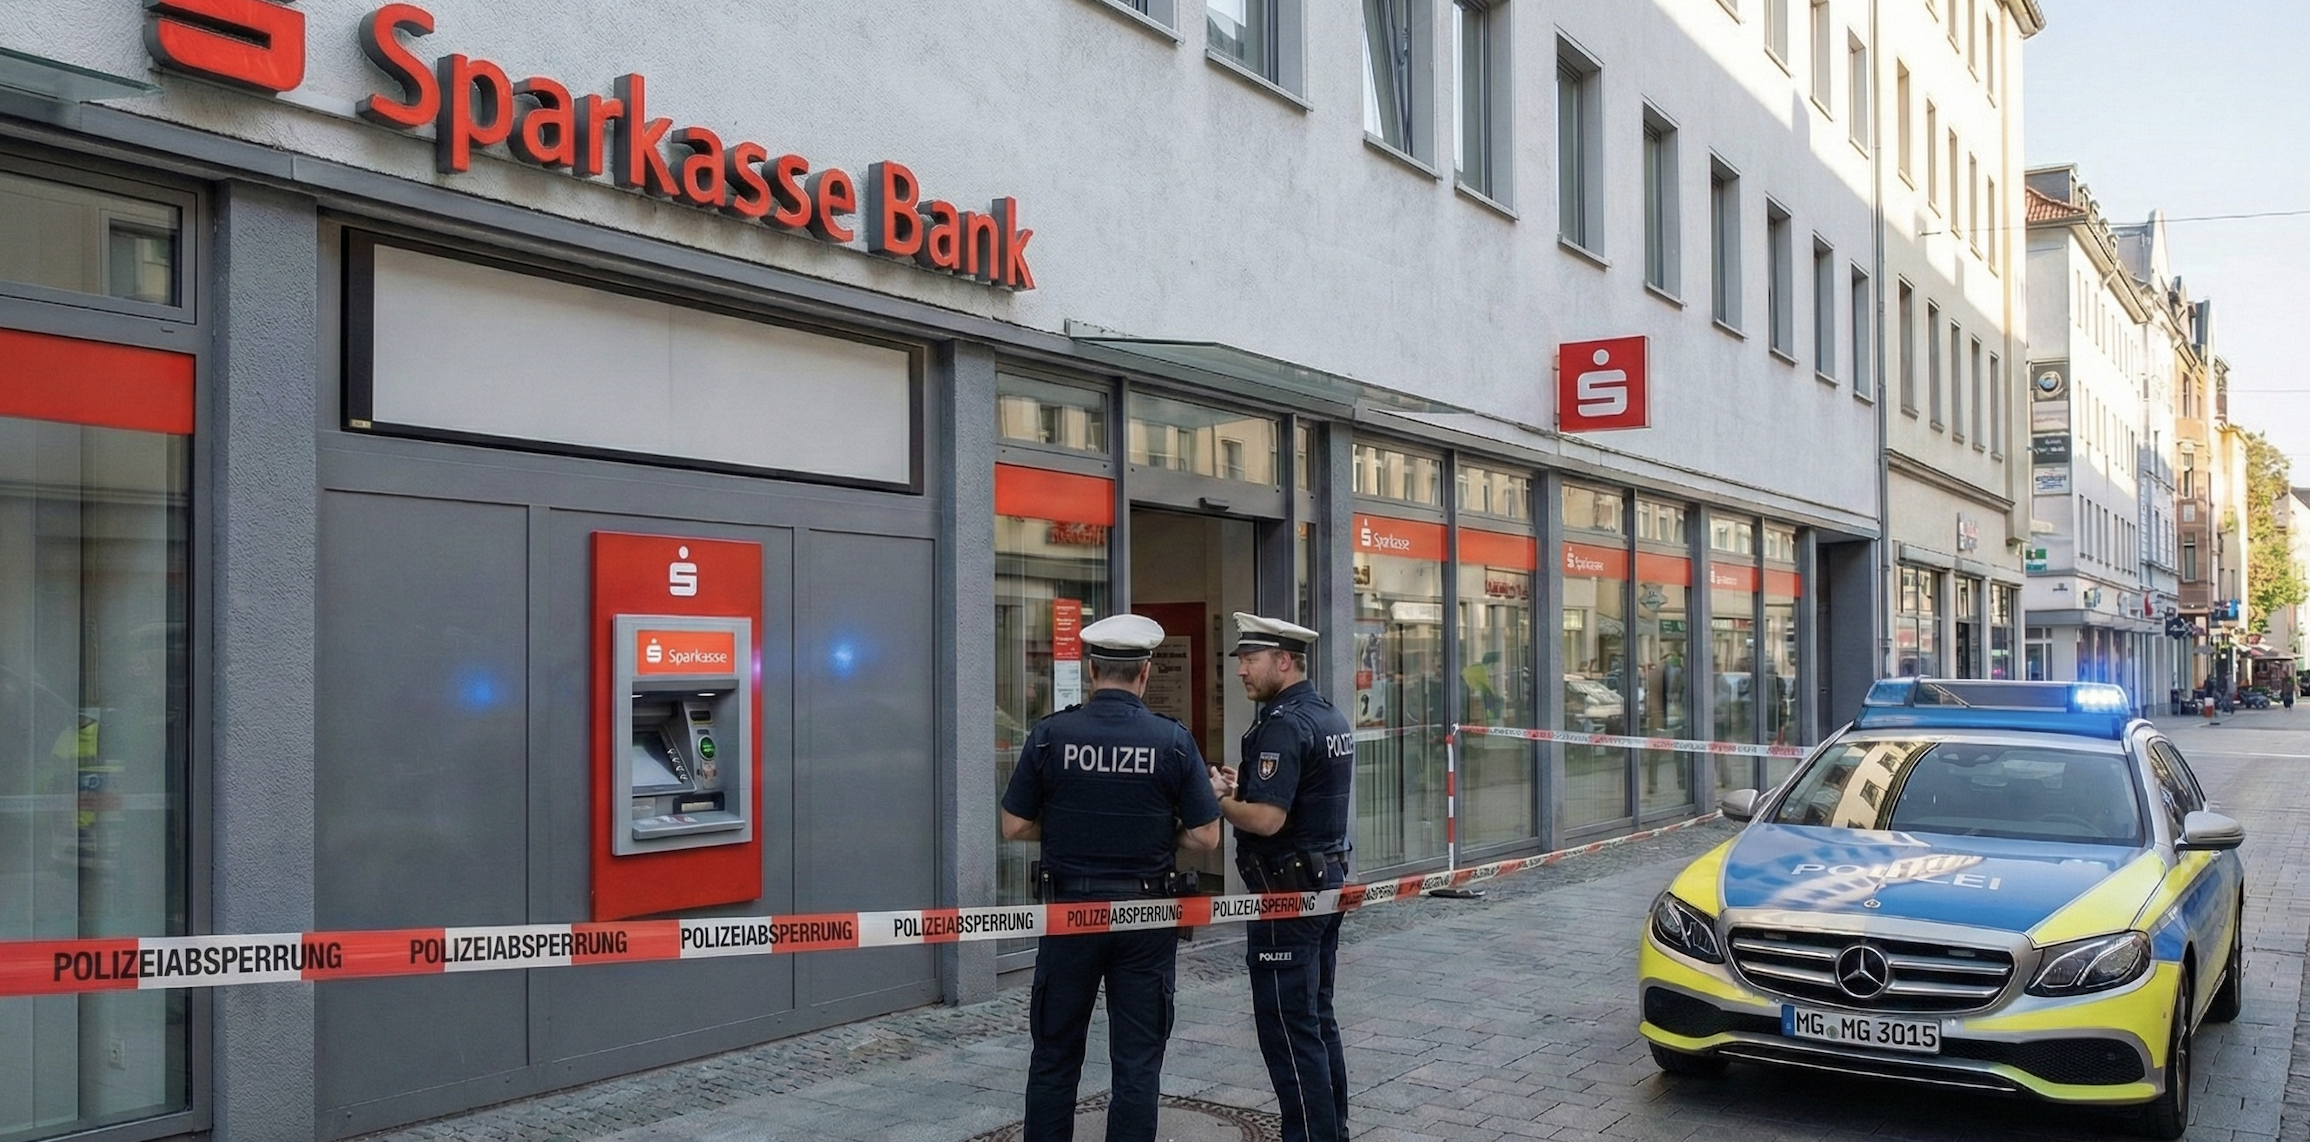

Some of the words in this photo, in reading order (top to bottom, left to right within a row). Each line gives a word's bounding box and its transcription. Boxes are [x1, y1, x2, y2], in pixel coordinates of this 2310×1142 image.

[356, 3, 856, 243] Sparkasse
[869, 160, 1036, 290] Bank
[668, 648, 728, 666] Sparkasse
[1063, 743, 1156, 774] POLIZEI
[894, 912, 1034, 937] POLIZEIABSPERRUNG
[1067, 904, 1183, 927] POLIZEIABSPERRUNG
[410, 931, 627, 964] POLIZEIABSPERRUNG
[681, 921, 853, 949] POLIZEIABSPERRUNG
[53, 941, 342, 982] POLIZEIABSPERRUNG
[1259, 952, 1290, 961] POLIZEI
[1796, 1011, 1824, 1036] MG
[1841, 1018, 1871, 1042] MG
[1876, 1021, 1937, 1048] 3015
